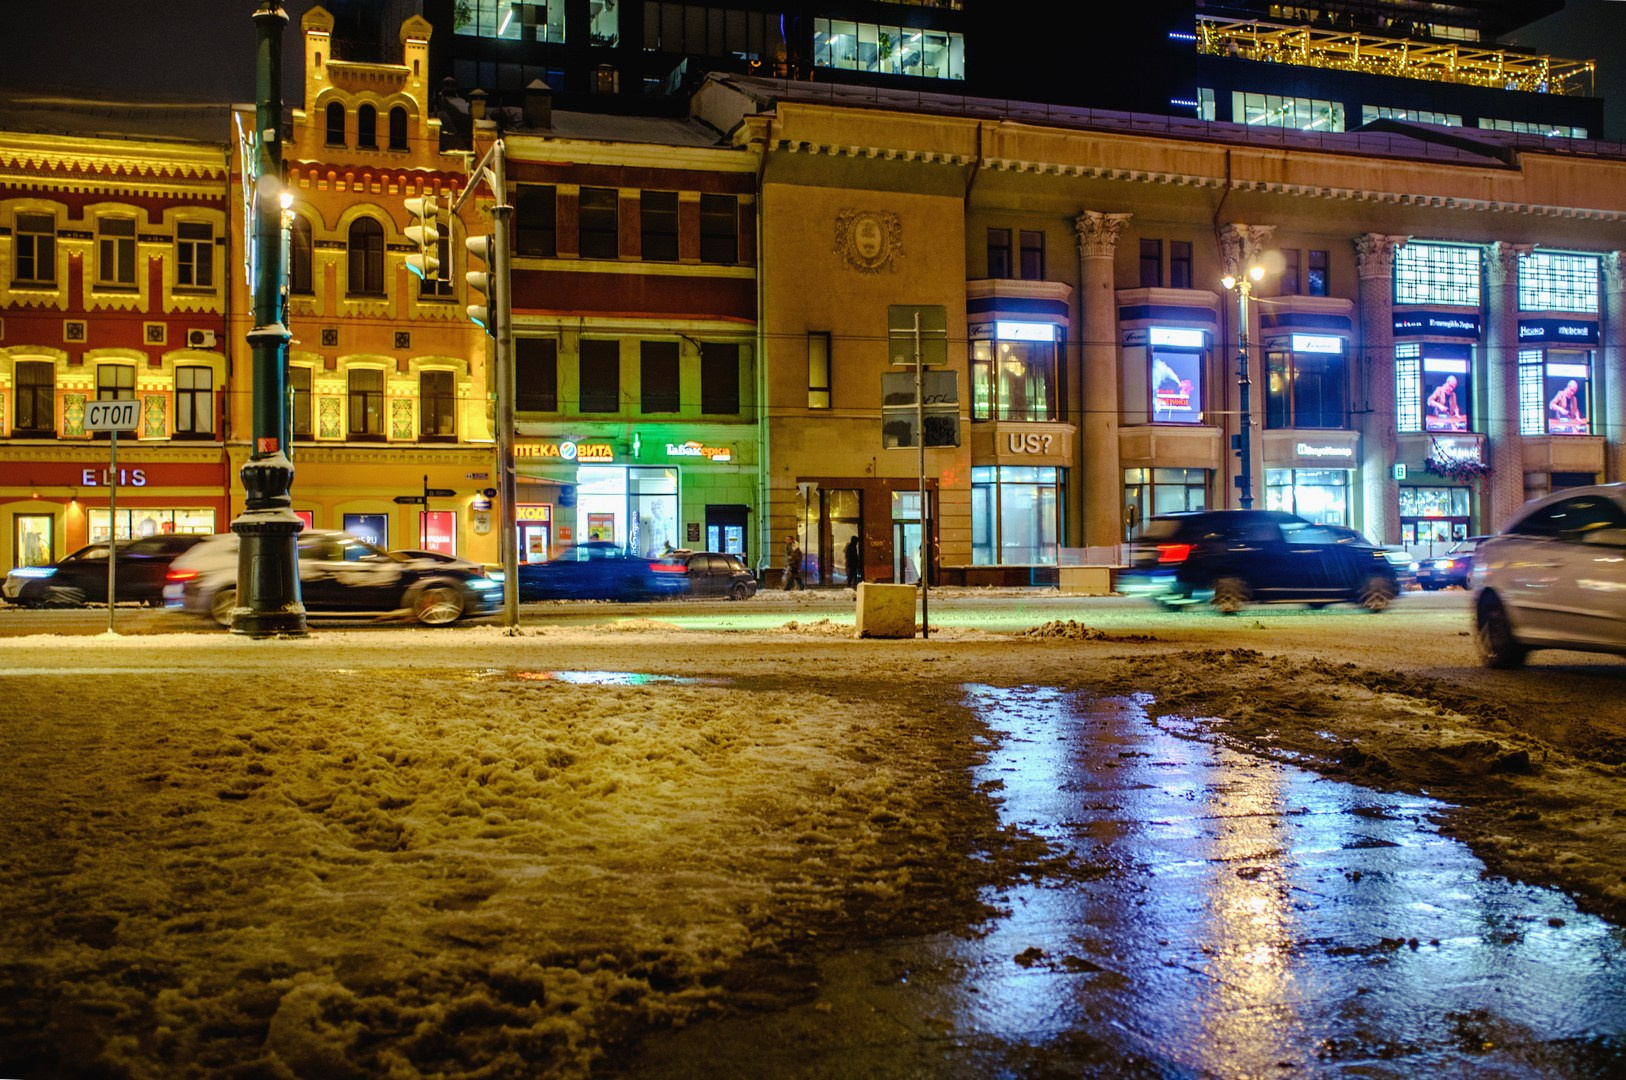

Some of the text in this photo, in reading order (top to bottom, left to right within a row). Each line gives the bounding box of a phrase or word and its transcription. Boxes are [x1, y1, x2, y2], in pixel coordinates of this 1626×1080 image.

[90, 405, 133, 425] СТОП
[513, 443, 614, 457] ПТЕКА ВИТА
[1009, 433, 1053, 454] US?
[82, 468, 147, 487] ELIS
[516, 507, 546, 521] ХОД
